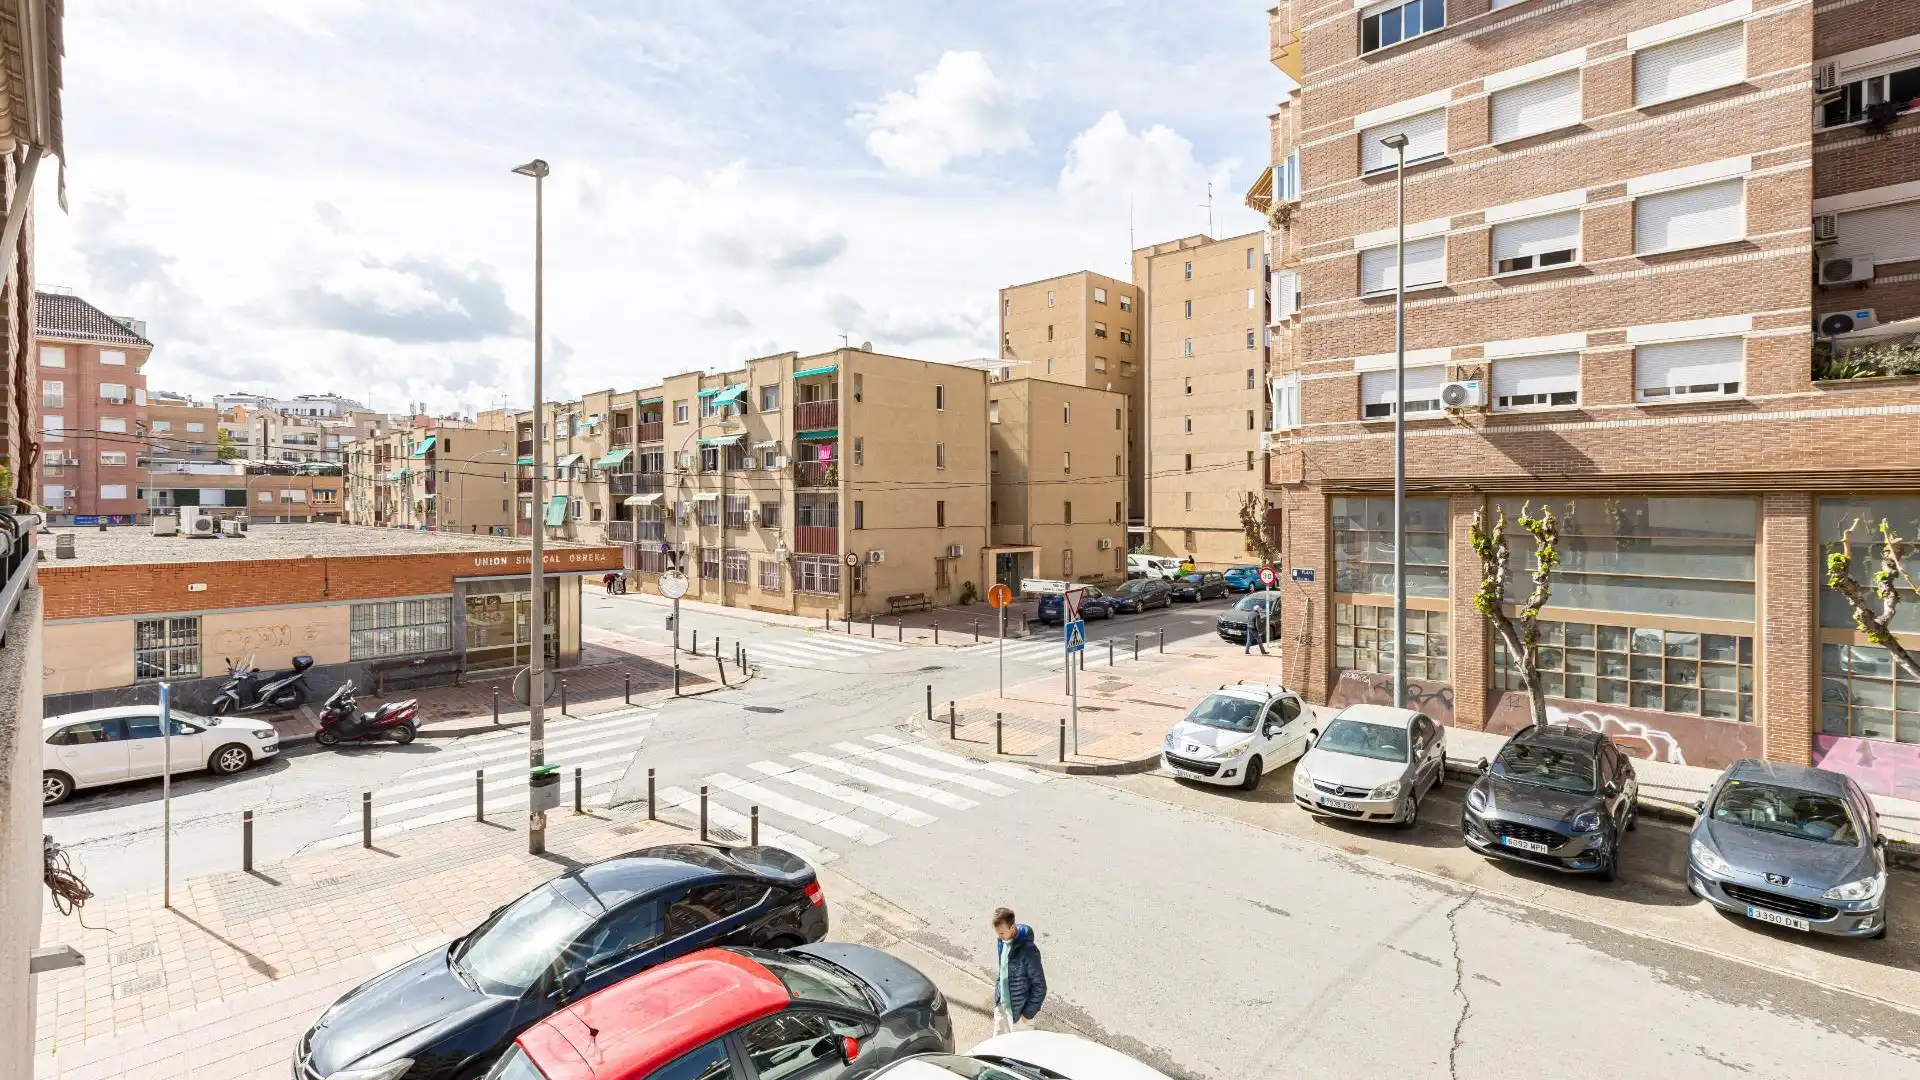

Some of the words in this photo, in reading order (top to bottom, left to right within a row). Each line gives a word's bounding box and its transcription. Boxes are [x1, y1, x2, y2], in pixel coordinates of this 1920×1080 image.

[474, 557, 507, 567] UNION
[516, 555, 561, 565] SINCAL
[569, 553, 606, 563] OBRERA
[1262, 572, 1272, 580] 30
[1755, 910, 1782, 924] 3390
